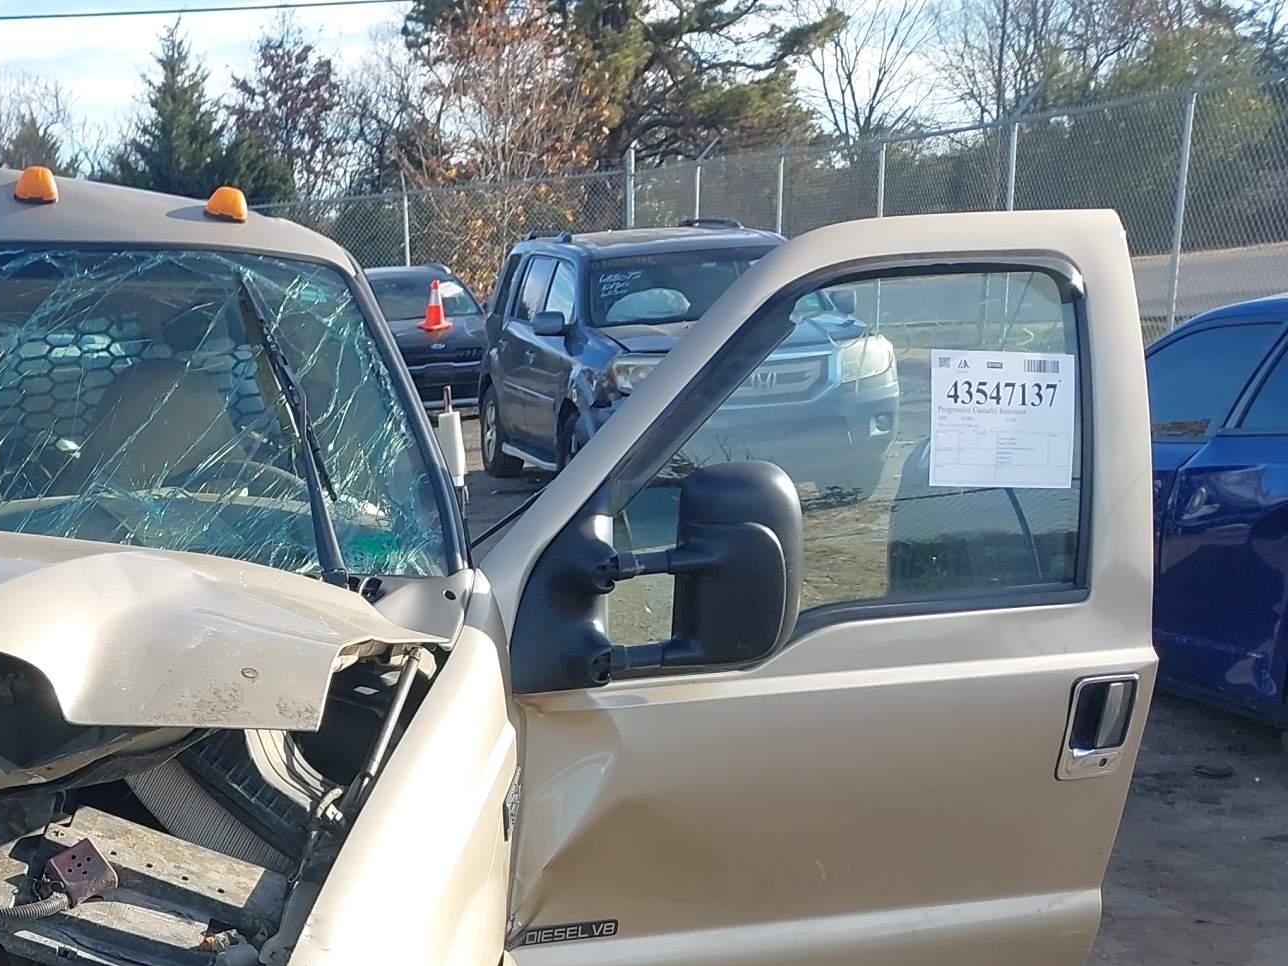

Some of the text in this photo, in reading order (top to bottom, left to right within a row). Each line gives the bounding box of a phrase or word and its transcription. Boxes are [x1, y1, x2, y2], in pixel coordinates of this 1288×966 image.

[947, 380, 1058, 407] 43547137
[525, 922, 616, 944] DIESEL V8
